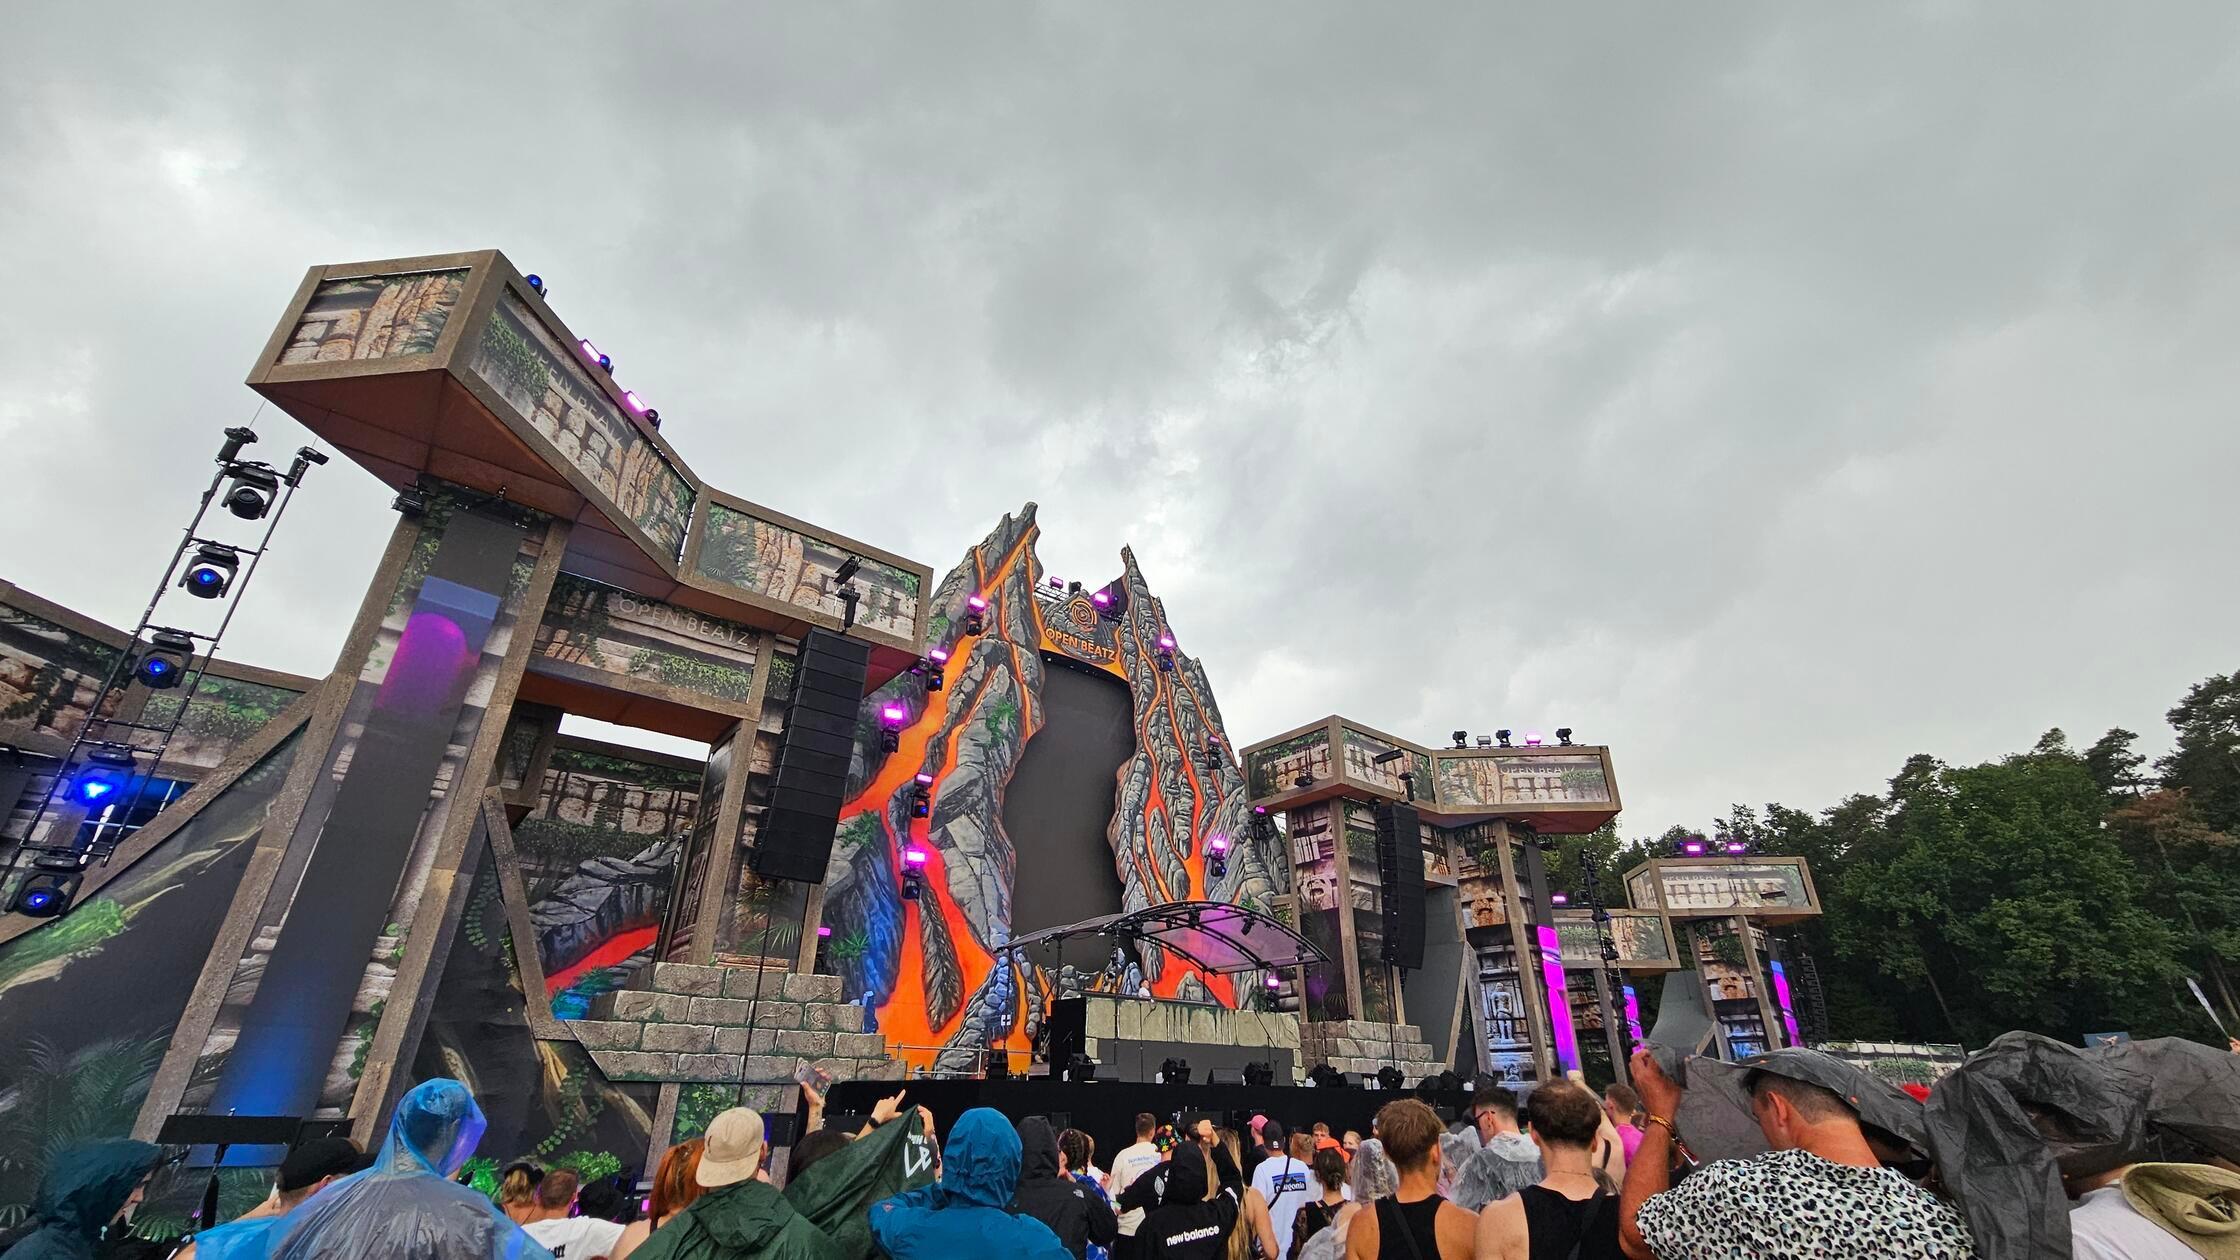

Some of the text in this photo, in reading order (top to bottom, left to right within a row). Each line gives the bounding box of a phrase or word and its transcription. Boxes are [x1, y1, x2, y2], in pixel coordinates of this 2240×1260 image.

[619, 599, 750, 646] OPEN BEATZ
[1045, 628, 1116, 661] OPEN BEATZ
[1500, 766, 1535, 774] OPEN
[1275, 1182, 1305, 1193] ptagonia
